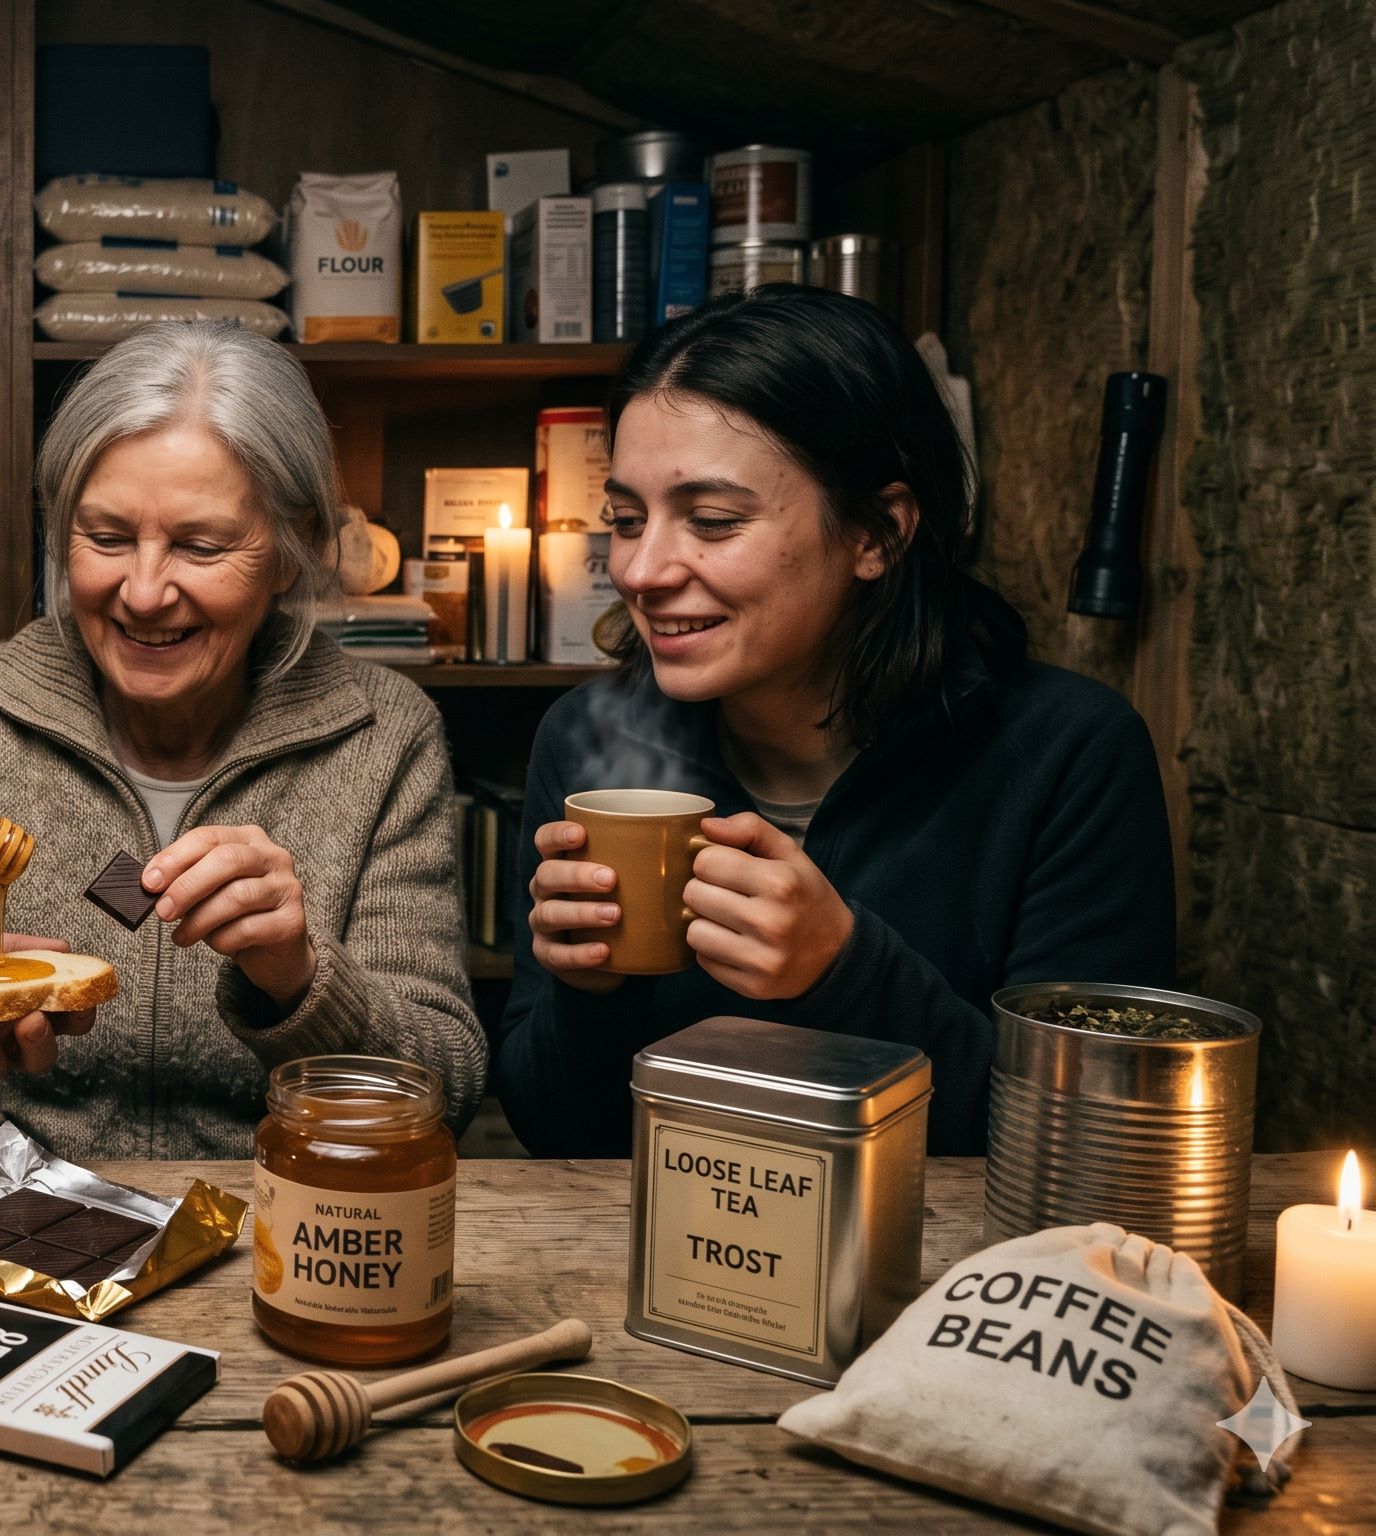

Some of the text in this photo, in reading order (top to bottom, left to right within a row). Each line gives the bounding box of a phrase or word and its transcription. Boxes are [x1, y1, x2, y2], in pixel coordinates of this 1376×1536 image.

[318, 257, 384, 273] FLOUR
[664, 1148, 813, 1198] LOOSE LEAF
[315, 1203, 382, 1220] NATURAL
[711, 1187, 759, 1218] TEA
[292, 1221, 403, 1256] AMBER
[687, 1234, 782, 1278] TROST
[293, 1253, 403, 1289] HONEY
[945, 1271, 1173, 1364] COFFEE
[926, 1313, 1137, 1400] BEANS
